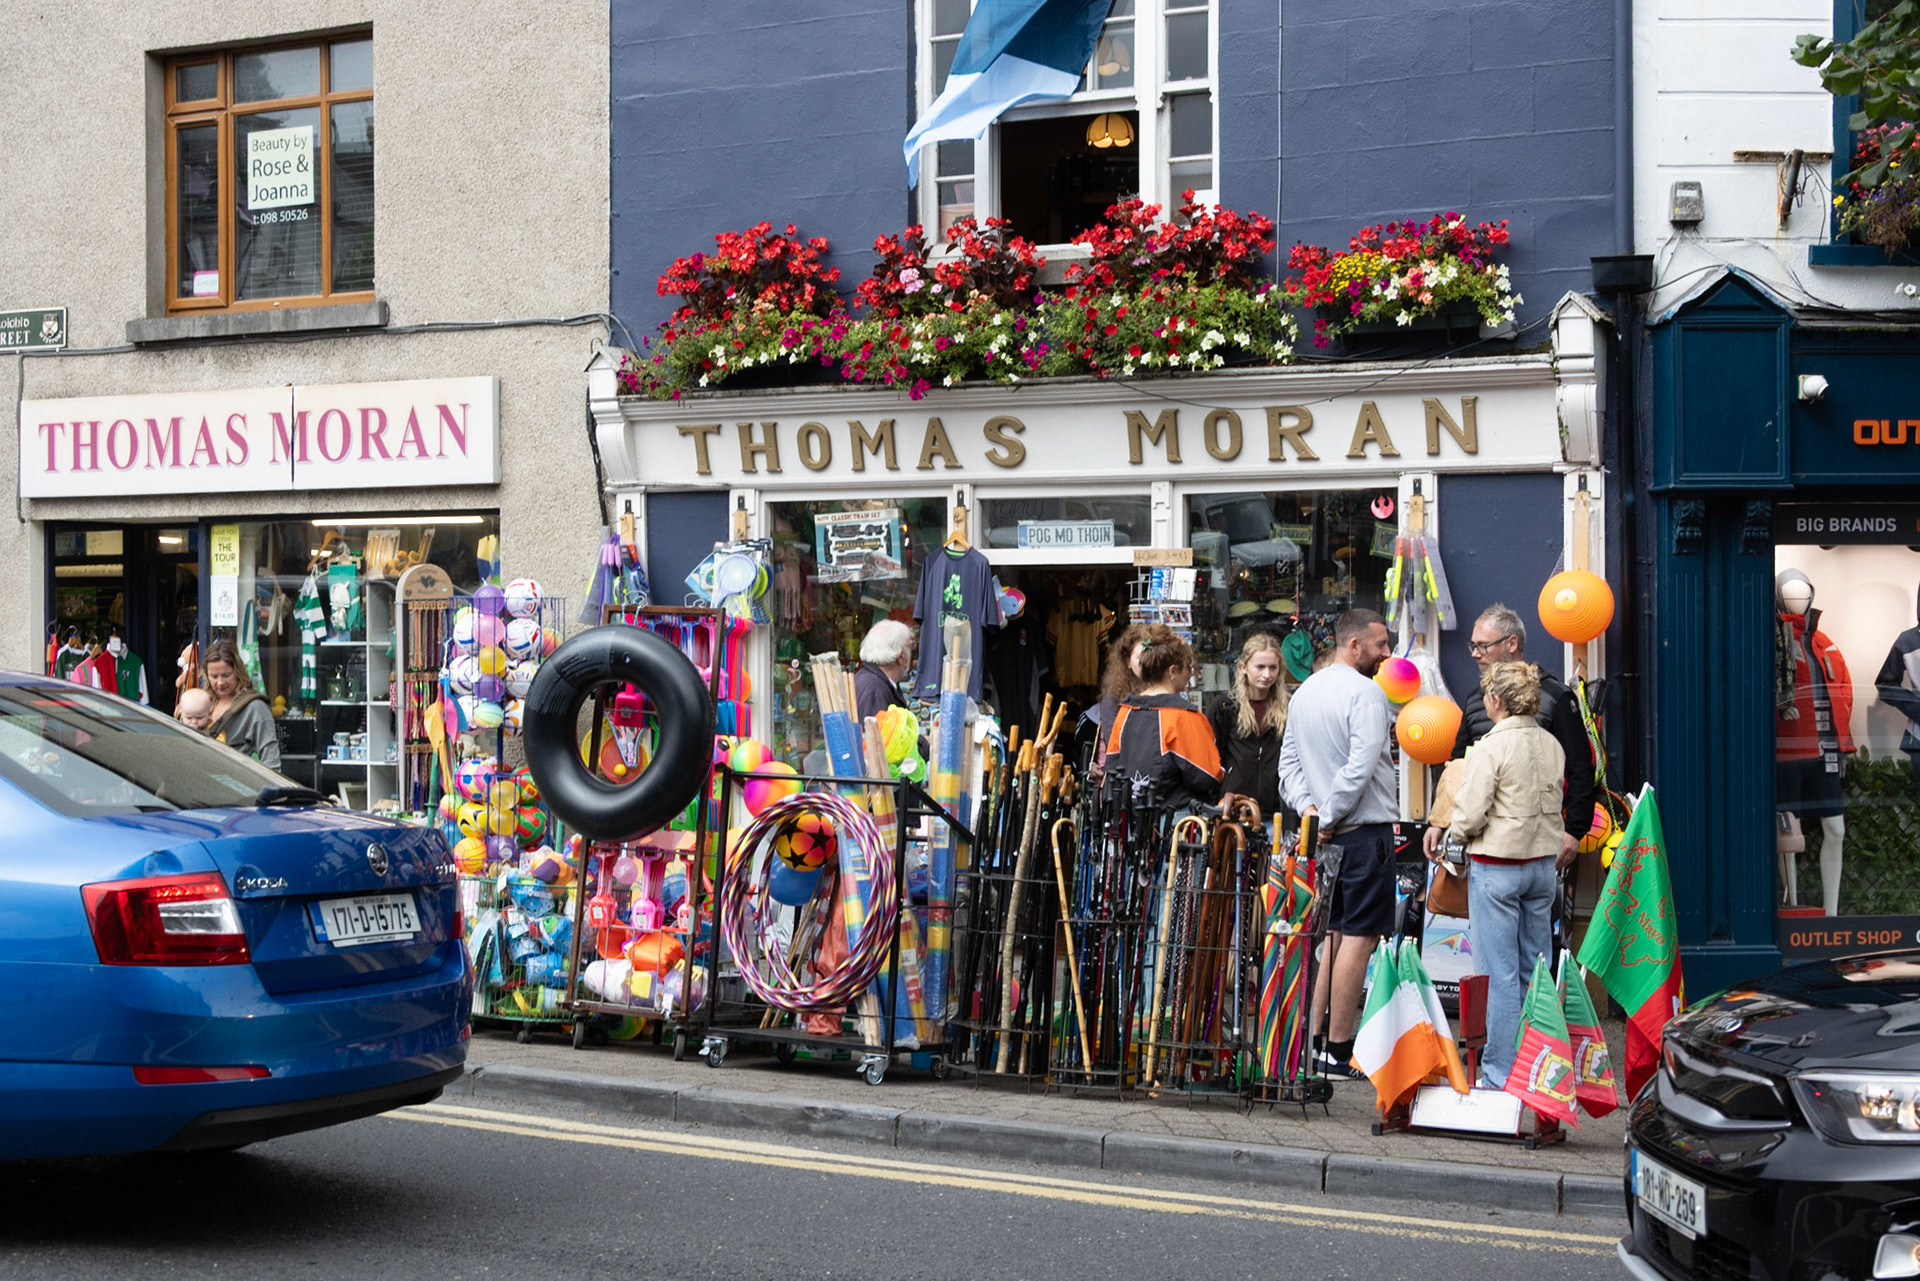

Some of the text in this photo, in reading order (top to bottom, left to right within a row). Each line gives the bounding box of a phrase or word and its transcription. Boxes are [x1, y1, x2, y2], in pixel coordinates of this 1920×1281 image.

[252, 134, 307, 152] Beauty by
[252, 153, 309, 178] Rose &
[252, 183, 308, 203] Joanna
[279, 208, 309, 223] 50526
[38, 402, 471, 474] THOMAS MORAN
[676, 395, 1479, 475] THOMAS MORAN
[1028, 526, 1111, 543] POG MO THOIN
[1796, 517, 1825, 533] BIG
[1828, 517, 1897, 533] BRANDS
[218, 543, 232, 552] THE
[214, 553, 236, 563] TOUR
[332, 903, 412, 936] 171-D-15775
[1636, 911, 1666, 946] Mayo
[1790, 931, 1853, 947] OUTLET
[1857, 930, 1903, 945] SHOP
[1642, 1165, 1697, 1226] 181-MO-259
